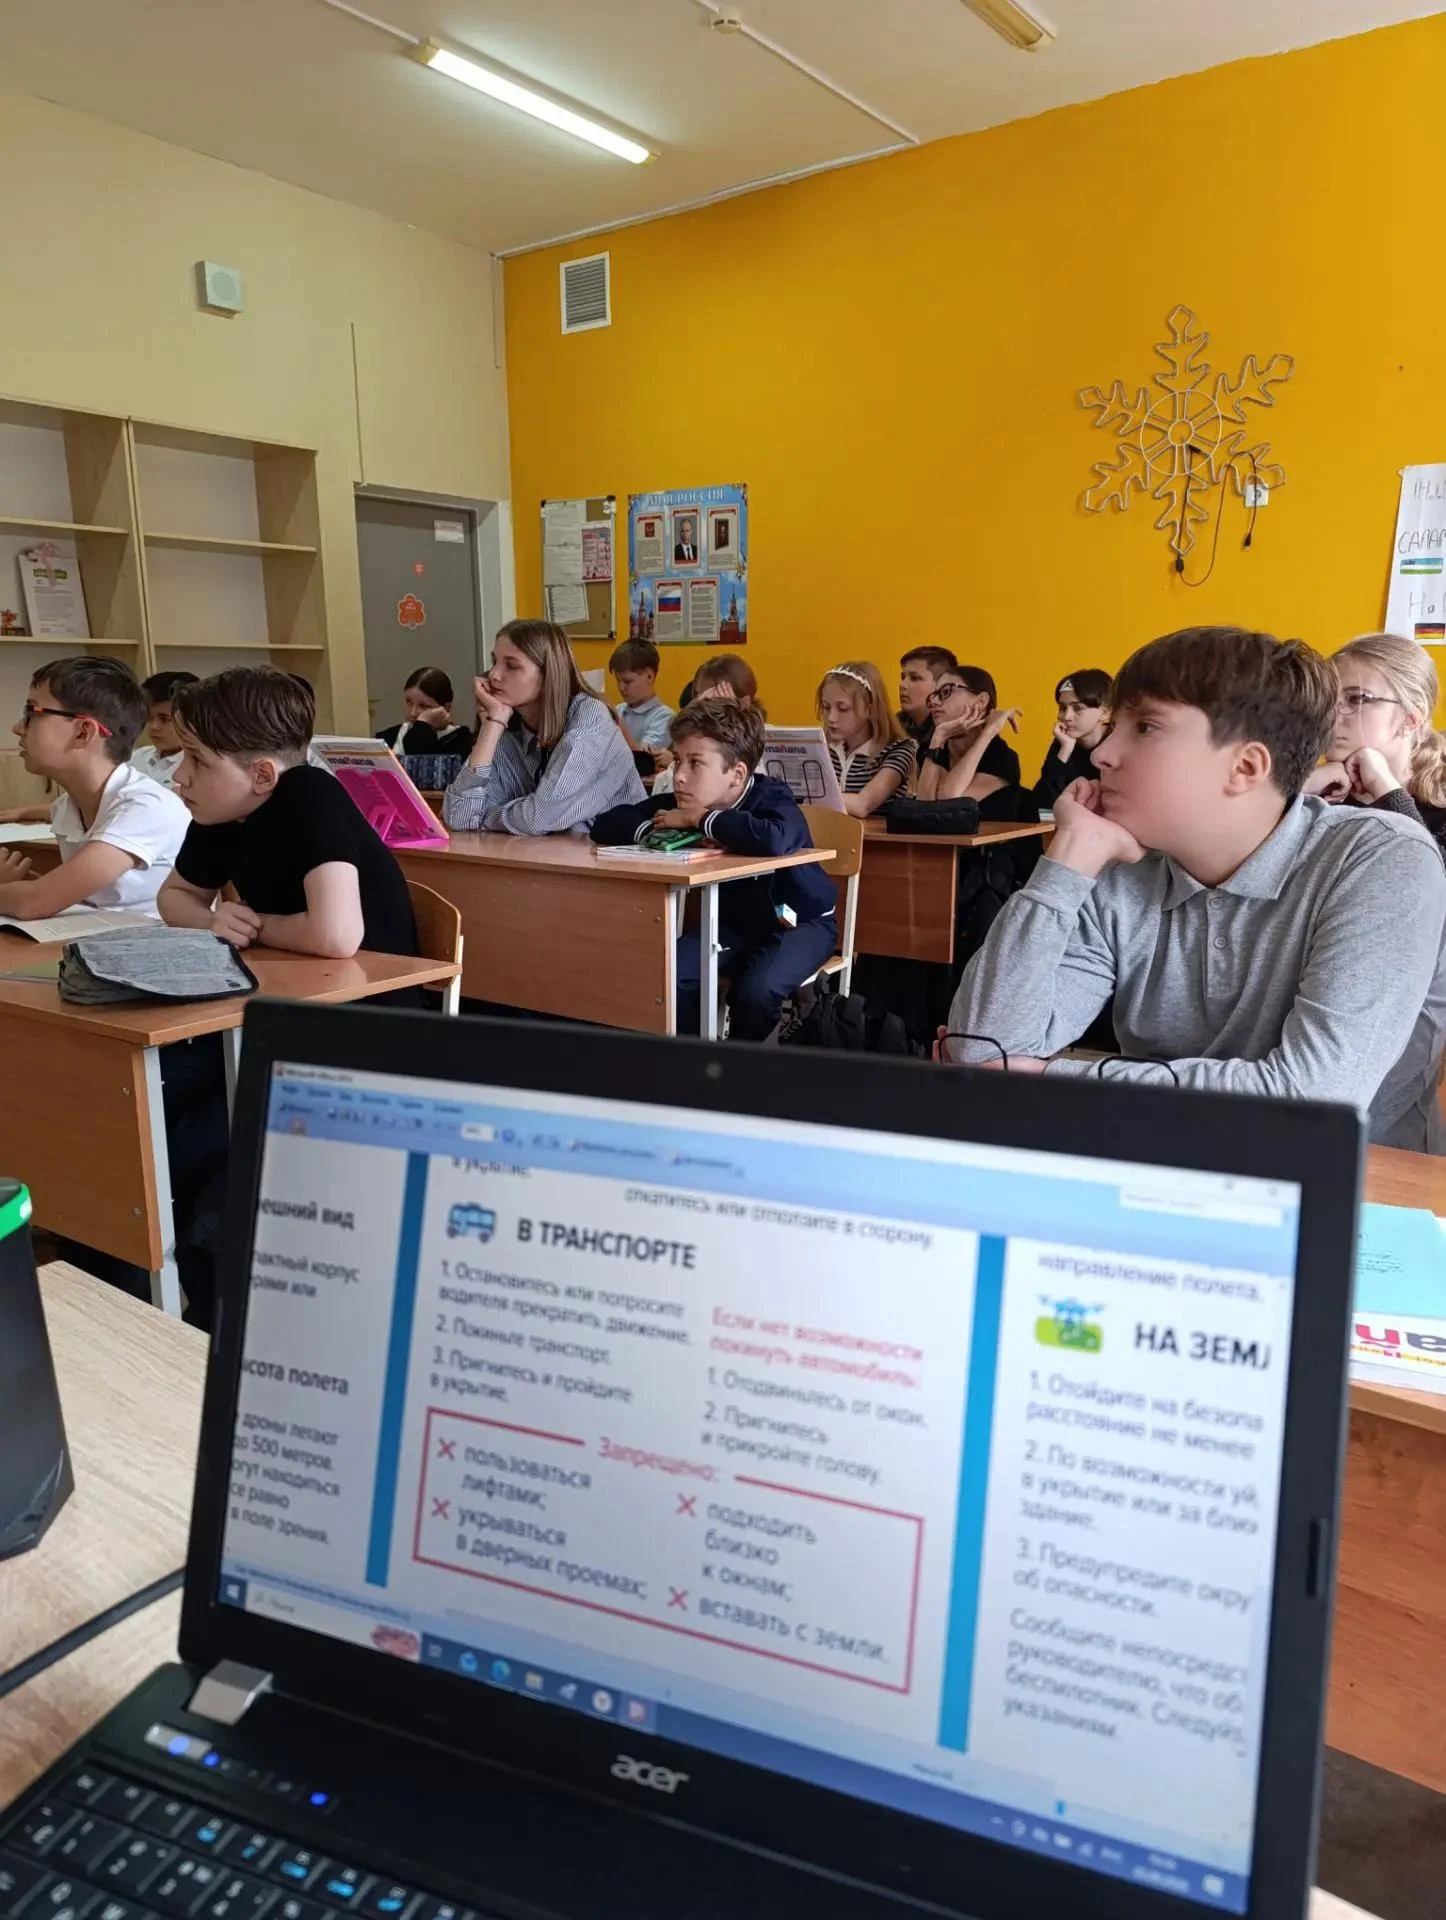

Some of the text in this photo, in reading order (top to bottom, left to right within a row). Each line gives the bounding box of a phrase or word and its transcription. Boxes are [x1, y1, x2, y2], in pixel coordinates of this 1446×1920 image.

[648, 487, 724, 505] МОЯ РОССИЯ
[260, 1198, 317, 1221] ешний
[540, 1220, 696, 1269] ТРАНСПОРТЕ
[251, 1274, 289, 1293] рами
[252, 1435, 278, 1457] 500
[610, 1754, 689, 1793] acer
